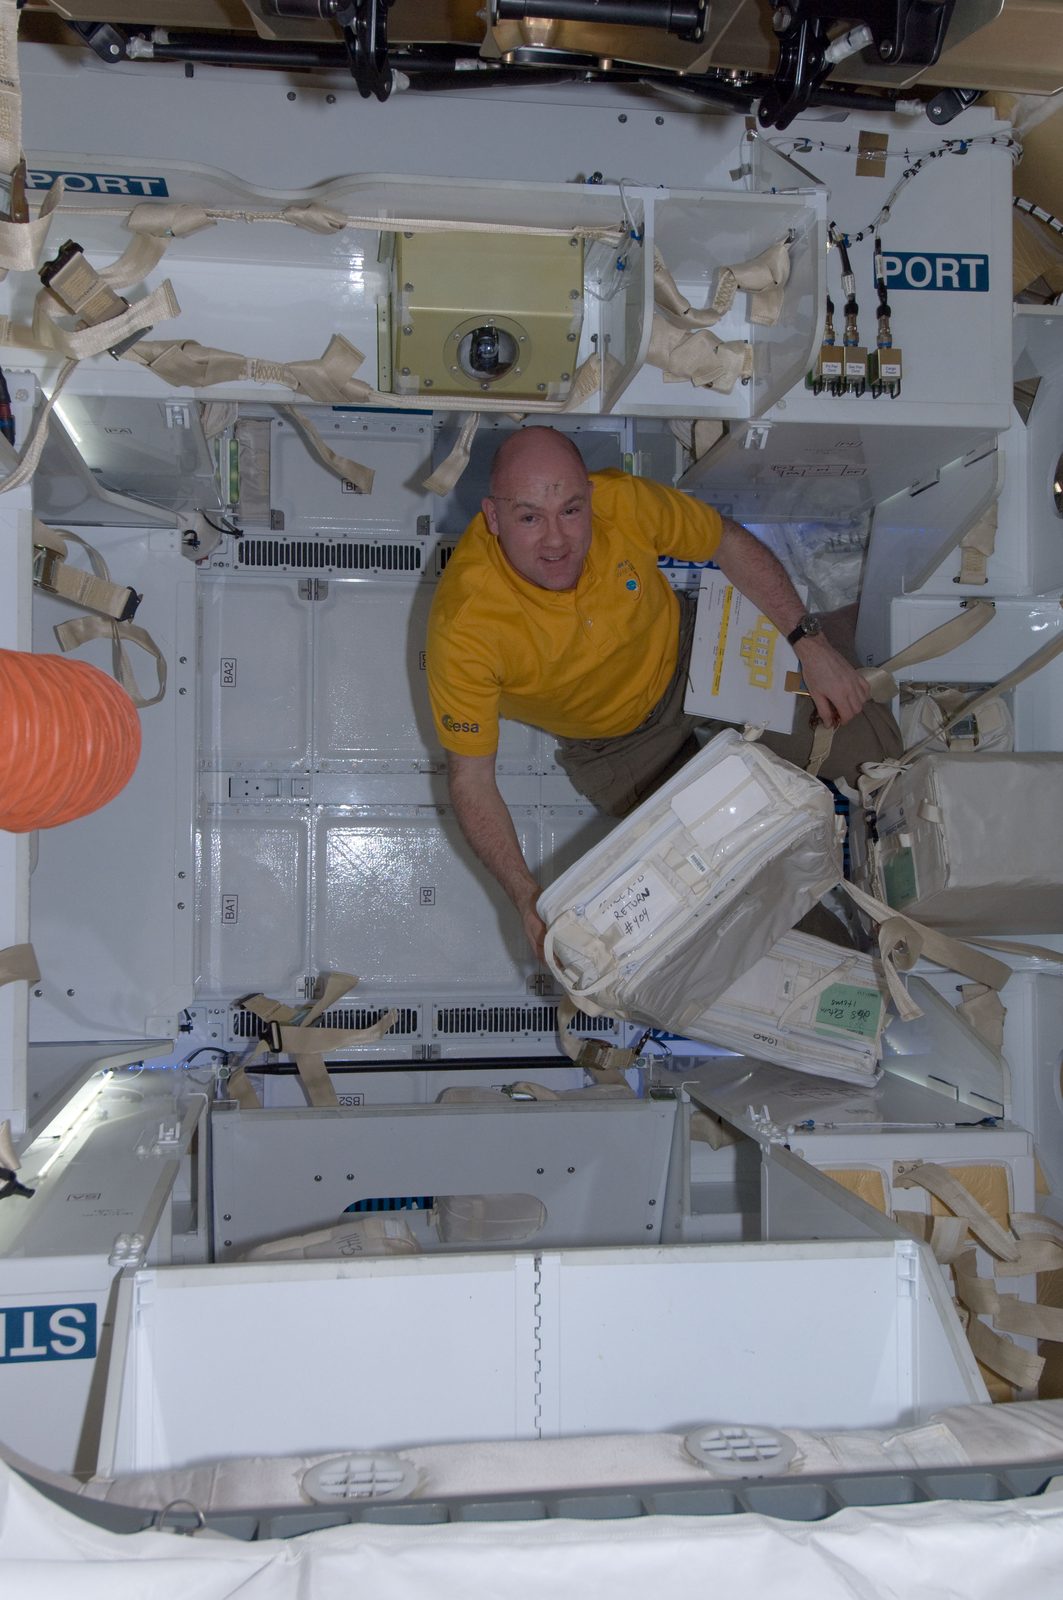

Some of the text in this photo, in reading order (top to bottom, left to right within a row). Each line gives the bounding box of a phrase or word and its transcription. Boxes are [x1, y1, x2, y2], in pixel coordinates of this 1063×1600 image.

[26, 171, 159, 195] PORT
[882, 255, 985, 289] PORT
[224, 661, 234, 684] BA2
[423, 889, 432, 903] B4
[613, 887, 650, 921] RETURN
[225, 899, 235, 920] BA1
[624, 907, 650, 935] #404
[0, 1308, 87, 1358] ST
